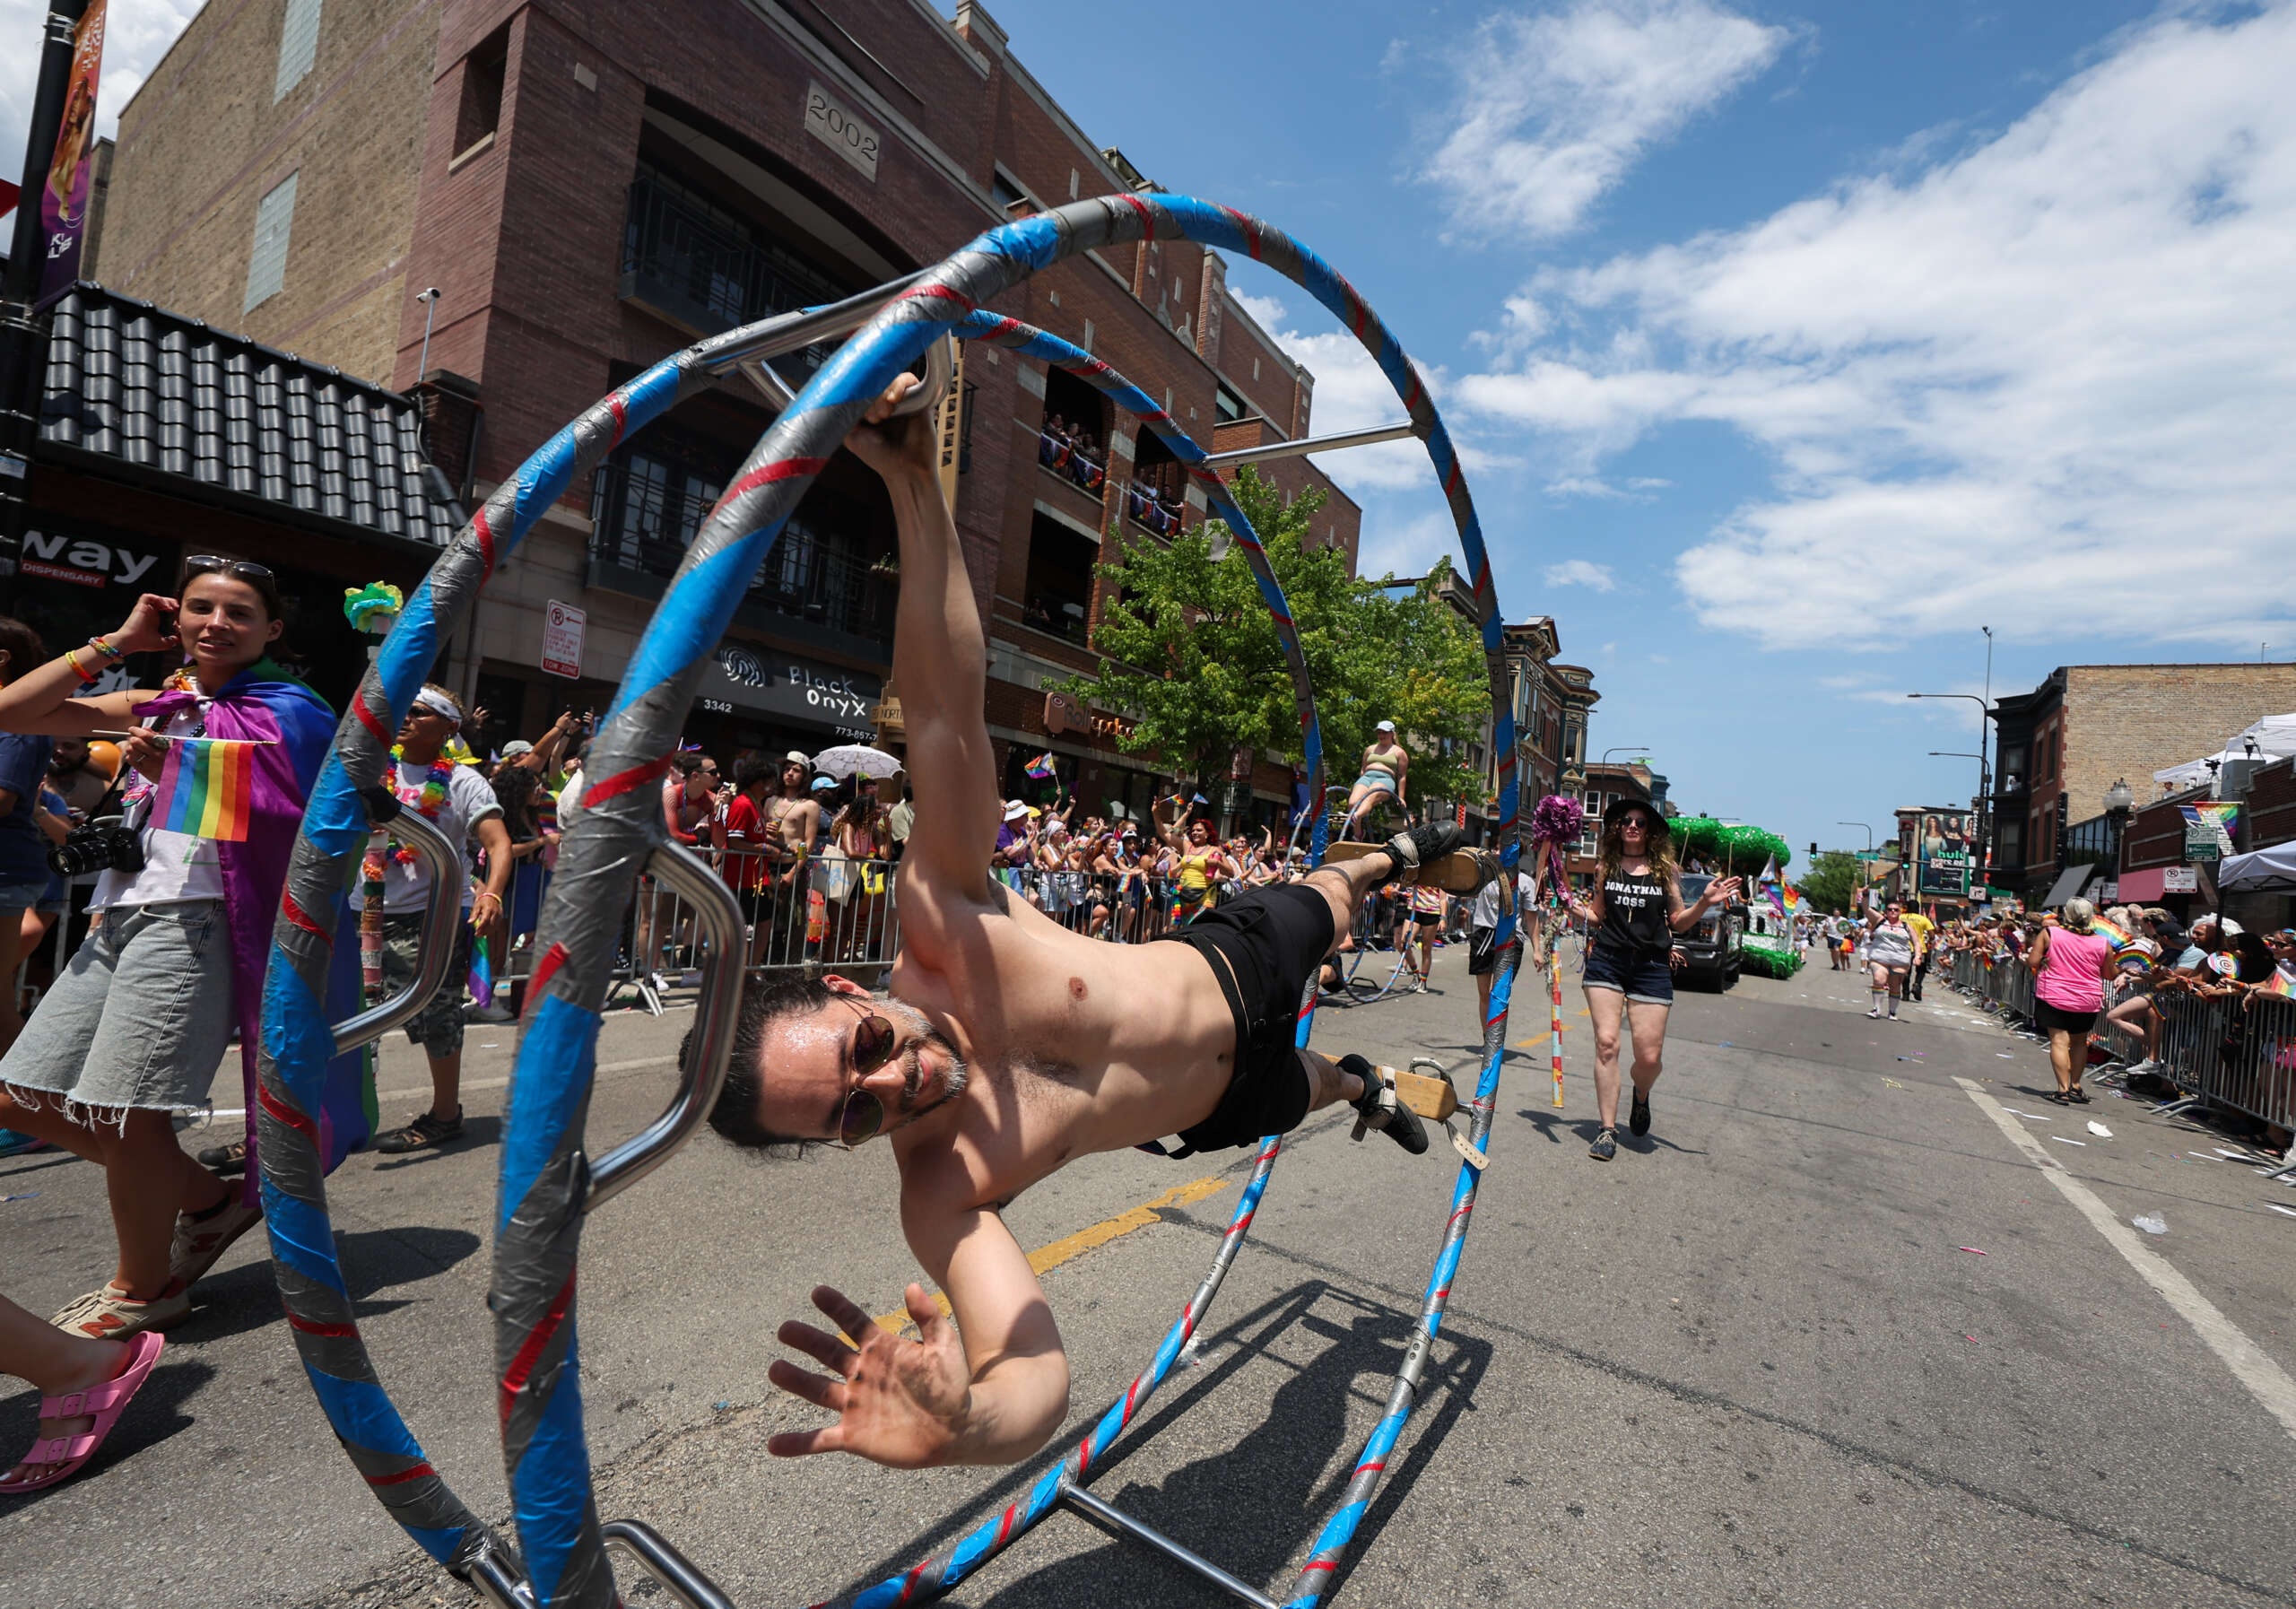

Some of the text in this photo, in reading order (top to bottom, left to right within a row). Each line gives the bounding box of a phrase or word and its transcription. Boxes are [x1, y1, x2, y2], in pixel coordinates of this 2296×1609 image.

[809, 95, 876, 161] 2002
[22, 562, 100, 583] DISPENSARY
[789, 666, 858, 700] Black
[704, 700, 732, 713] 3342
[806, 689, 865, 717] Onyx
[1605, 881, 1663, 896] JONATHAN
[1614, 895, 1647, 909] JOSS
